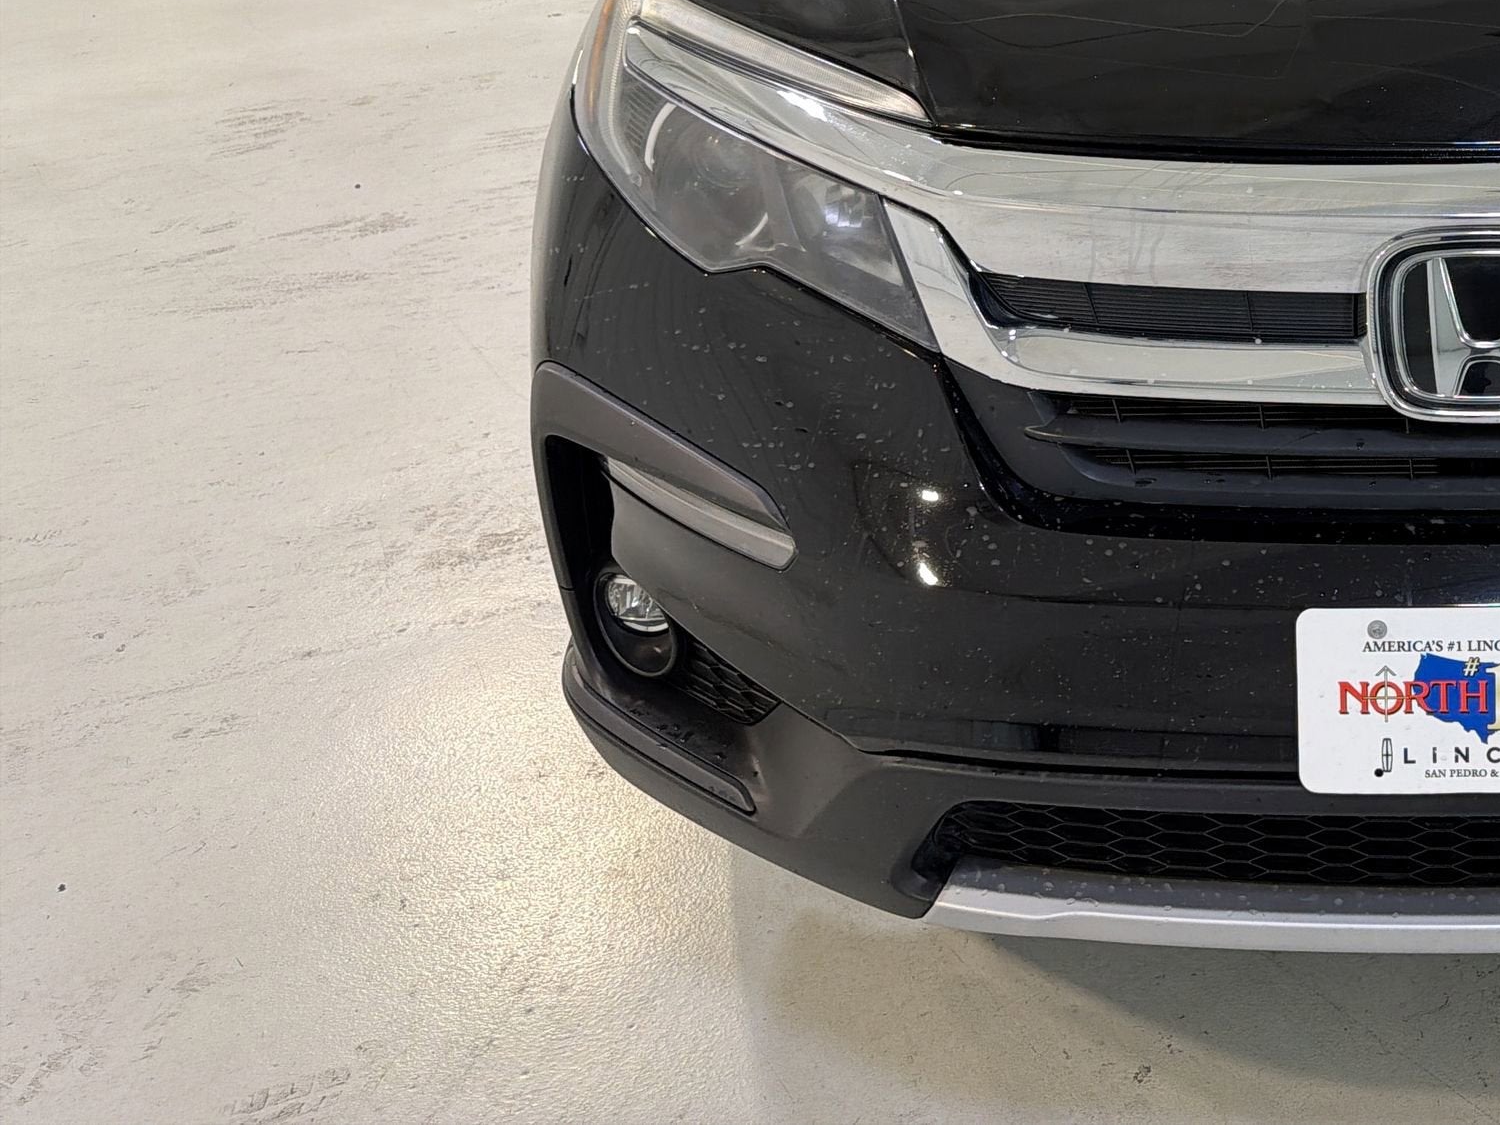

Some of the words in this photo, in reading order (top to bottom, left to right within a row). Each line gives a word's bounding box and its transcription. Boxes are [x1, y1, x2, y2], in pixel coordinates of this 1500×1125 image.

[1362, 639, 1443, 652] AMERICA'S
[1447, 639, 1463, 652] #1
[1337, 679, 1489, 715] NORTH
[1424, 769, 1446, 778] SAN
[1450, 768, 1487, 778] PEDRO
[1490, 768, 1500, 778] &
